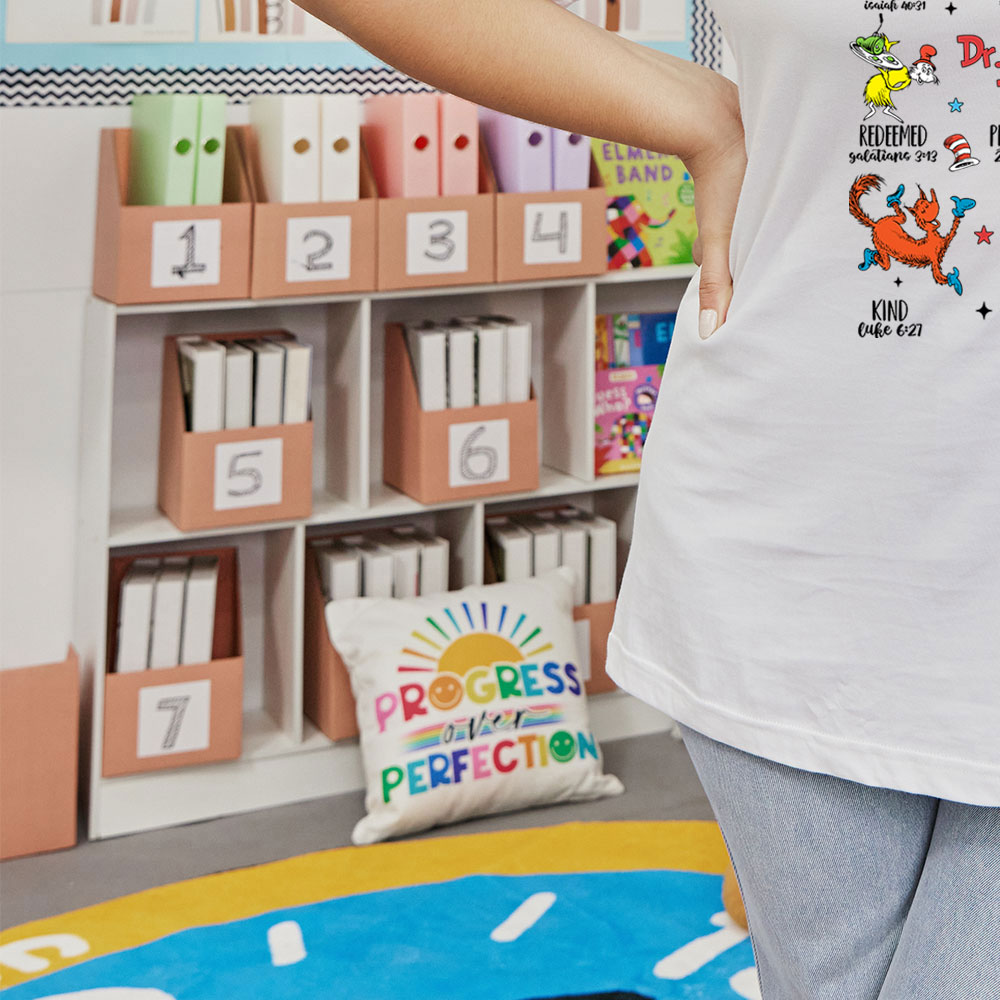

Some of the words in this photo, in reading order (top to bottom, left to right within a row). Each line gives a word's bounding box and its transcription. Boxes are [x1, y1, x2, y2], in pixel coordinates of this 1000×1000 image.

[860, 122, 927, 147] REDEEMED
[616, 164, 673, 184] BAND
[848, 149, 912, 165] galatians
[914, 149, 939, 164] 3:13
[171, 224, 207, 279] 1
[302, 229, 334, 272] 2
[424, 219, 456, 261] 3
[531, 211, 568, 254] 4
[857, 320, 893, 338] luke
[895, 320, 924, 338] 6:27
[872, 299, 908, 323] KIND
[227, 449, 264, 497] 5
[459, 425, 499, 481] 6
[374, 661, 582, 734] PROGRESS
[156, 695, 190, 749] 7
[441, 710, 527, 744] over
[381, 731, 599, 804] PERFECTION
